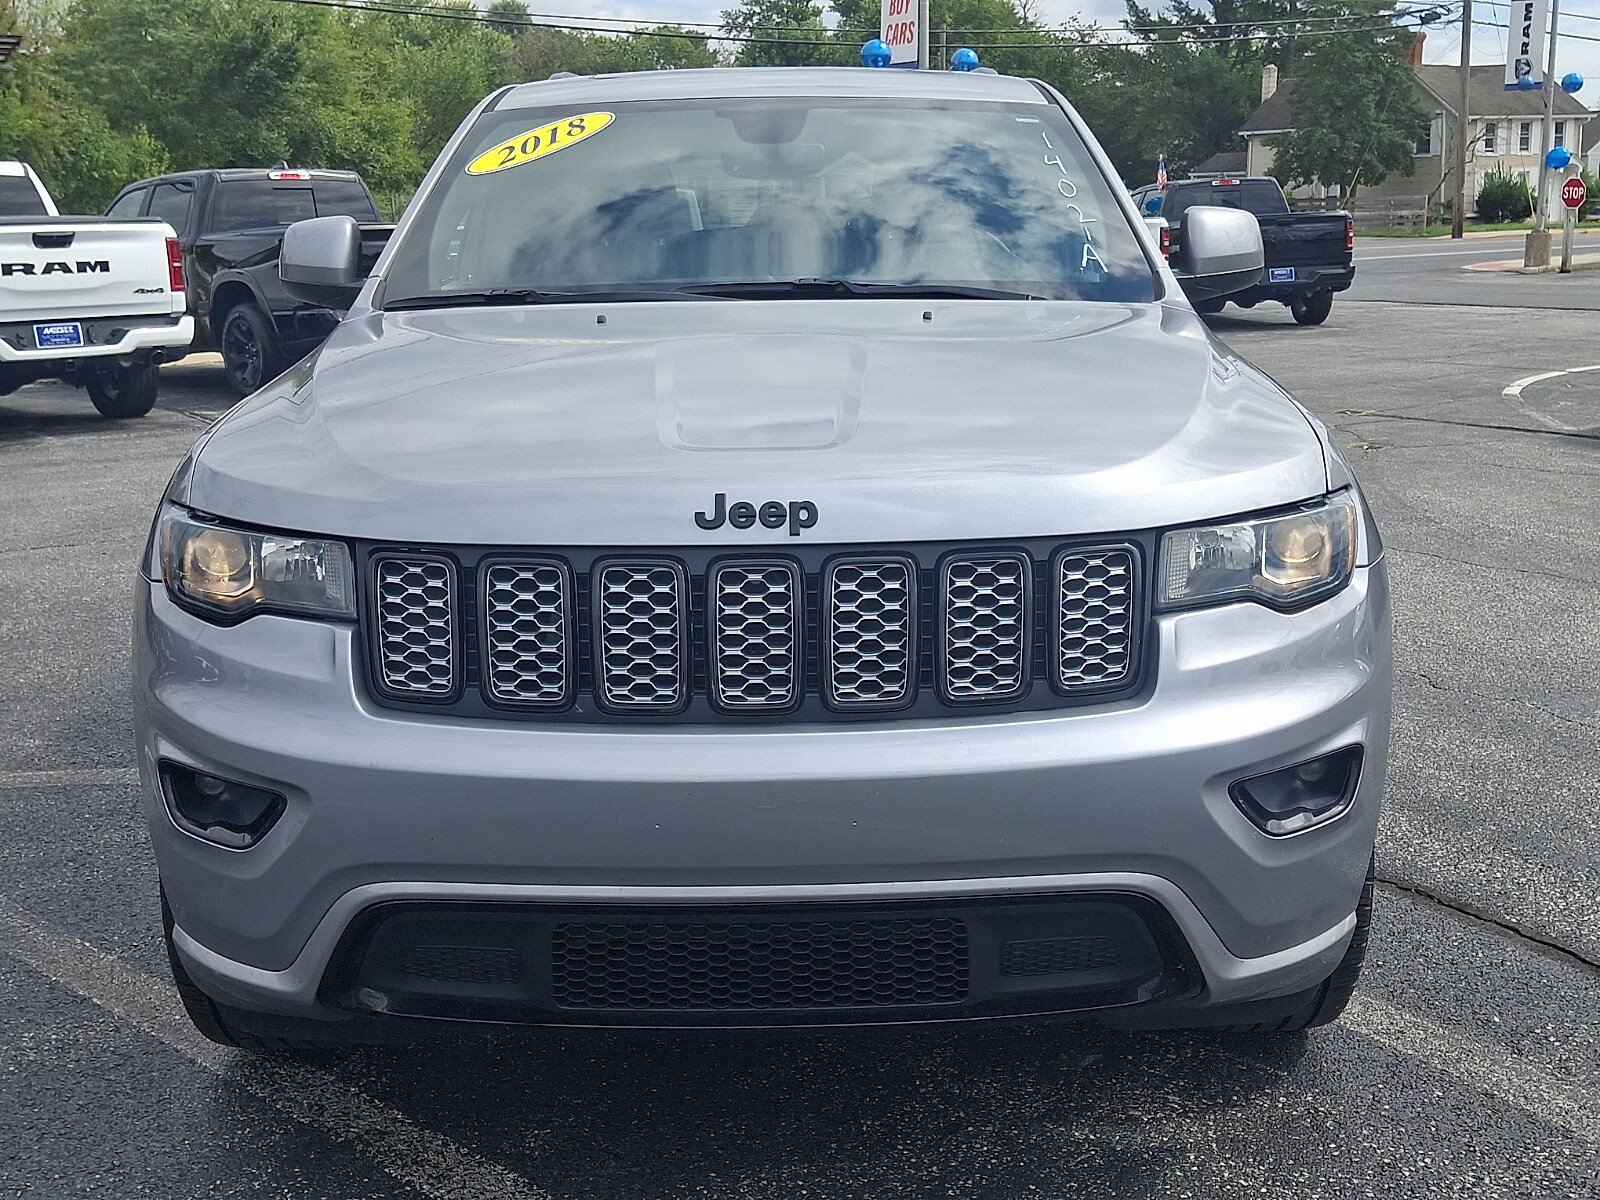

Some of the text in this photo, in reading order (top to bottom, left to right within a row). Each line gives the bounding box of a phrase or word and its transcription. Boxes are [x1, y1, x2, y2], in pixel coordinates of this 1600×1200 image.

[889, 0, 911, 16] BUY
[885, 21, 915, 46] CARS
[1521, 2, 1534, 55] RAM
[497, 118, 586, 167] 2018
[1563, 186, 1584, 199] STOP
[1, 260, 110, 276] RAM
[694, 492, 819, 537] Jeep
